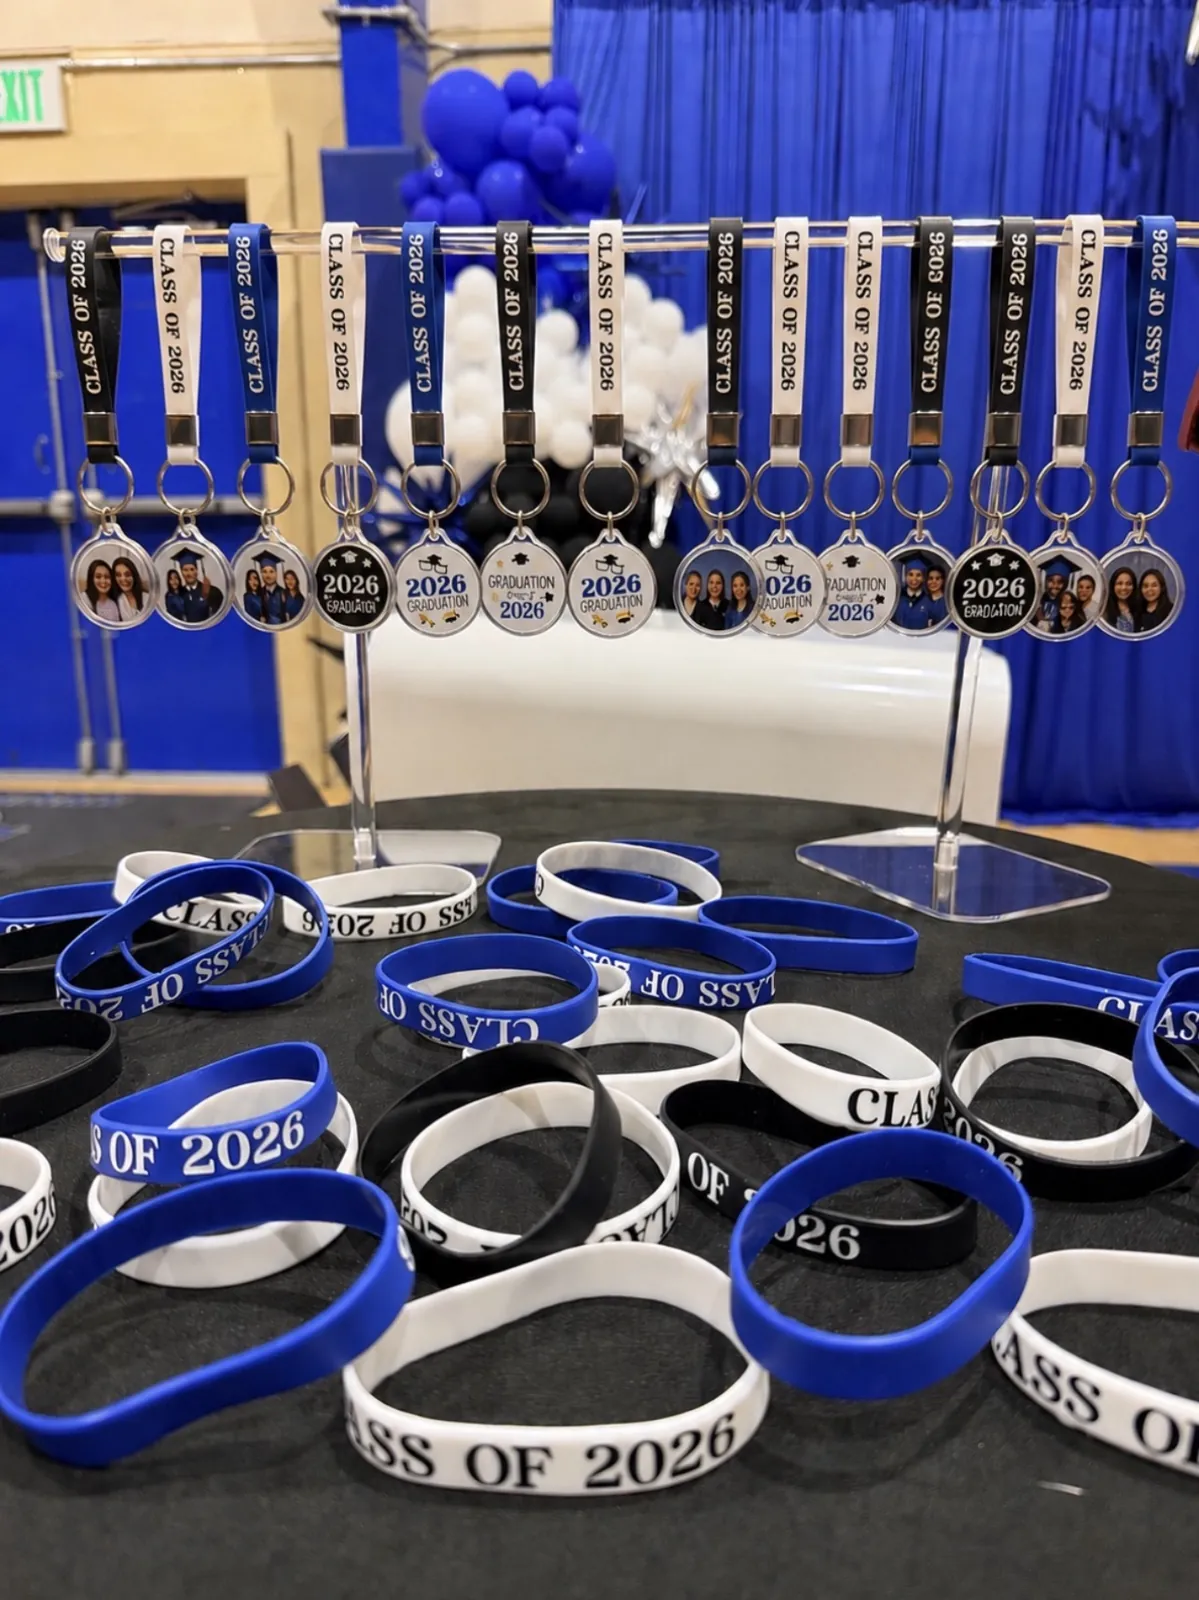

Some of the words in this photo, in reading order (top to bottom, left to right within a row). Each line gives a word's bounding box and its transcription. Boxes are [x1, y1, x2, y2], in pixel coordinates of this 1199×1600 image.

[0, 70, 43, 122] XIT
[71, 239, 87, 289] 2026
[160, 237, 177, 303] CLASS
[236, 236, 252, 287] 2026
[328, 233, 344, 299] CLASS
[408, 233, 425, 284] 2026
[504, 231, 519, 283] 2026
[597, 232, 614, 299] CLASS
[717, 232, 735, 285] 2026
[783, 230, 801, 299] CLASS
[855, 230, 874, 299] CLASS
[1009, 233, 1028, 286] 2026
[1077, 229, 1097, 299] CLASS
[1151, 228, 1169, 281] 2026
[72, 294, 91, 322] OF
[238, 292, 256, 321] OF
[331, 308, 346, 336] OF
[410, 290, 427, 319] OF
[504, 288, 521, 317] OF
[598, 308, 614, 336] OF
[717, 291, 734, 319] OF
[782, 306, 798, 335] OF
[854, 306, 871, 335] OF
[925, 290, 943, 319] OF
[1006, 292, 1024, 321] OF
[1074, 306, 1091, 335] OF
[1148, 287, 1166, 317] OF
[164, 312, 180, 340] OF
[77, 330, 102, 395] CLASS
[168, 346, 185, 394] 2026
[243, 329, 265, 394] CLASS
[333, 341, 350, 391] 2026
[412, 327, 433, 393] CLASS
[506, 325, 525, 392] CLASS
[599, 341, 614, 391] 2026
[715, 327, 733, 394] CLASS
[780, 341, 797, 391] 2026
[852, 341, 869, 391] 2026
[920, 327, 941, 393] CLASS
[1000, 329, 1021, 395] CLASS
[1069, 340, 1087, 391] 2026
[1142, 325, 1163, 392] CLASS
[323, 573, 379, 595] 2026
[406, 574, 467, 598] 2026
[407, 594, 469, 613] GRADUATION
[488, 574, 555, 589] GRADUATION
[580, 594, 643, 613] GRADUATION
[581, 573, 641, 598] 2026
[762, 594, 812, 611] ADUATION
[765, 574, 812, 596] 026
[826, 577, 886, 591] RADUATION
[962, 577, 1025, 599] 2026
[500, 601, 545, 619] 2026
[828, 604, 874, 621] 2026
[389, 911, 426, 935] OF
[141, 974, 184, 1013] OF
[380, 984, 407, 1020] OF
[641, 970, 684, 1001] OF
[699, 970, 776, 1007] LASS
[418, 1002, 539, 1048] CLASS
[848, 1087, 940, 1127] CLAS
[109, 1131, 159, 1175] OF
[181, 1110, 304, 1176] 2026
[688, 1153, 729, 1204] OF
[996, 1332, 1100, 1424] ASS
[465, 1443, 553, 1488] OF
[585, 1412, 736, 1489] 2026
